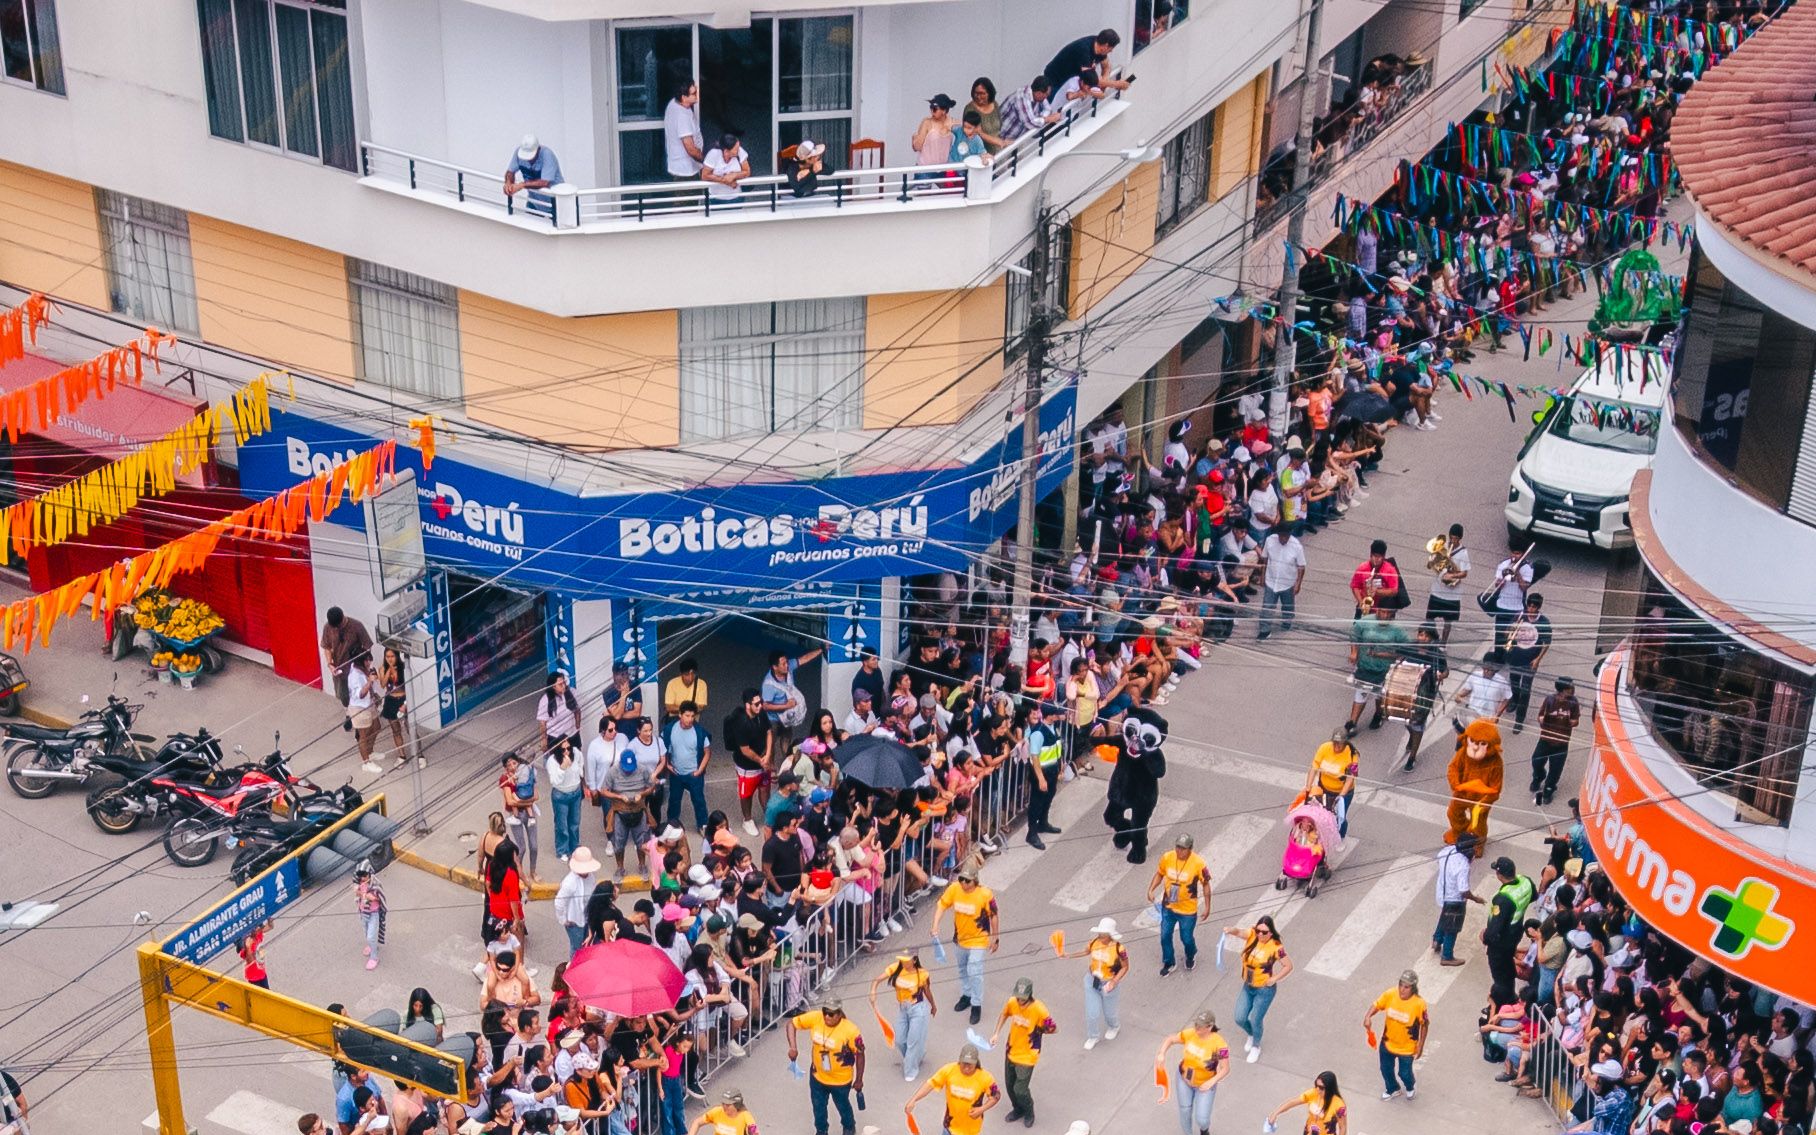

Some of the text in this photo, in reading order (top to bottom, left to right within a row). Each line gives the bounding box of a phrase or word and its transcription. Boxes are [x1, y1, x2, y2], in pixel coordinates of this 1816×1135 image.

[421, 520, 464, 543] ruanos
[466, 534, 501, 555] como
[434, 481, 524, 545] Perú
[619, 507, 794, 558] Boticas
[816, 494, 928, 543] Perú
[769, 547, 850, 567] ¡Peruanos
[853, 544, 898, 559] como
[431, 573, 453, 709] TICAS
[188, 903, 239, 947] ALMIRANTE
[239, 886, 265, 911] GRAU
[195, 934, 220, 960] SAN
